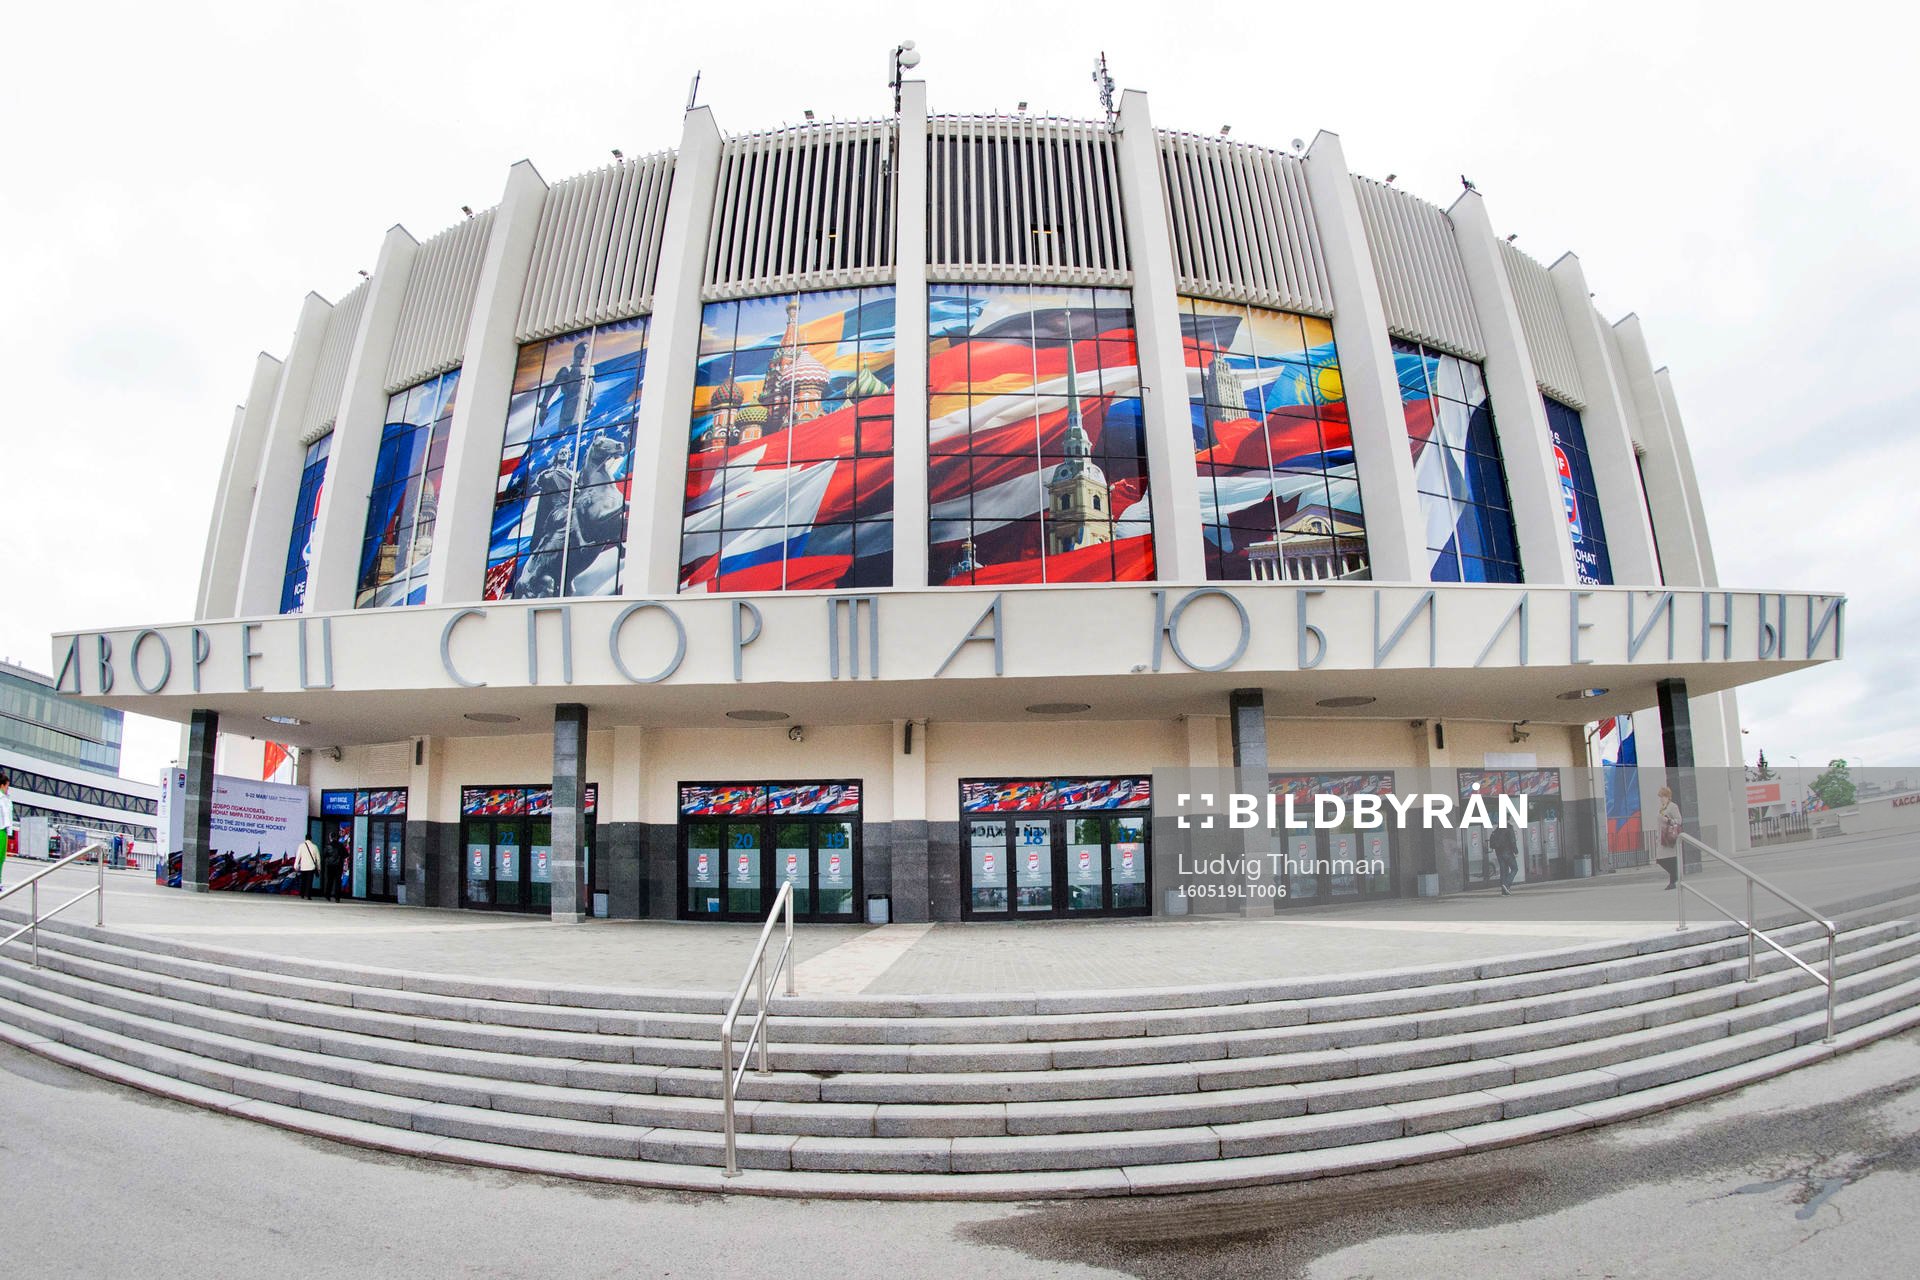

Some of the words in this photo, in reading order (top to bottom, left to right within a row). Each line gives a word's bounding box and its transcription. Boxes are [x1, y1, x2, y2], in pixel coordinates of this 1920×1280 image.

[1575, 549, 1597, 565] ОНАТ
[56, 616, 335, 695] ДВОРЕЦ
[1151, 587, 1848, 672] ЮБИЛЕЙНЫЙ
[266, 823, 286, 831] HOCKEY
[1119, 827, 1137, 843] 17
[500, 831, 514, 845] 22
[735, 832, 754, 849] 20
[826, 832, 845, 848] 19
[1023, 829, 1043, 845] 18
